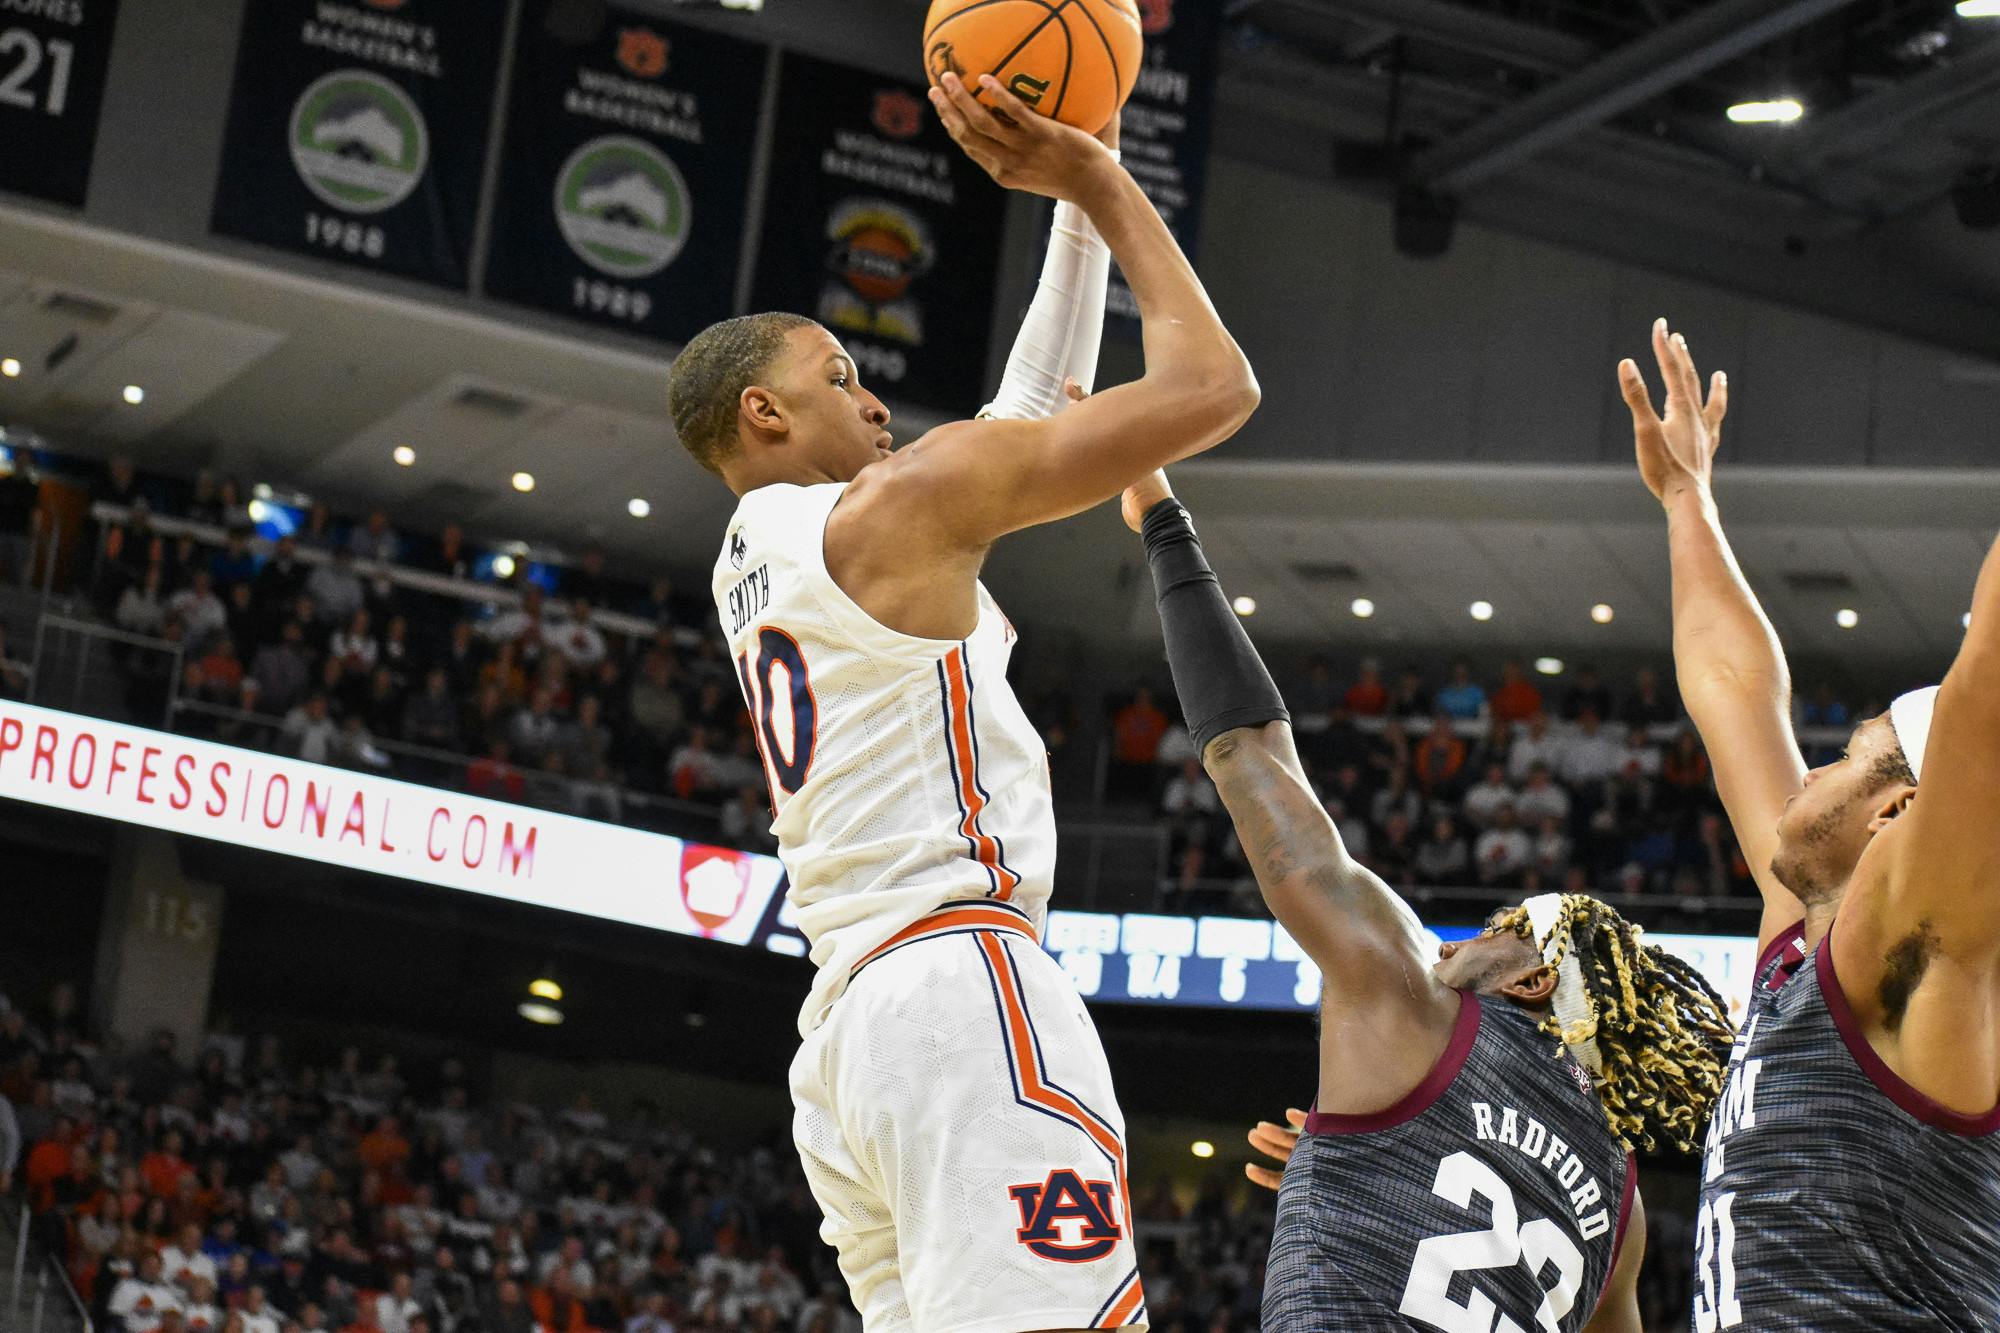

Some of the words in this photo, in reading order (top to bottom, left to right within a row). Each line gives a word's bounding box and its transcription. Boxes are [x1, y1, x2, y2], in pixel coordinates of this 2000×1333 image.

[0, 28, 73, 114] 21
[729, 563, 769, 635] SMITH
[1472, 1102, 1610, 1241] RADFORD
[1692, 1192, 1743, 1333] 31
